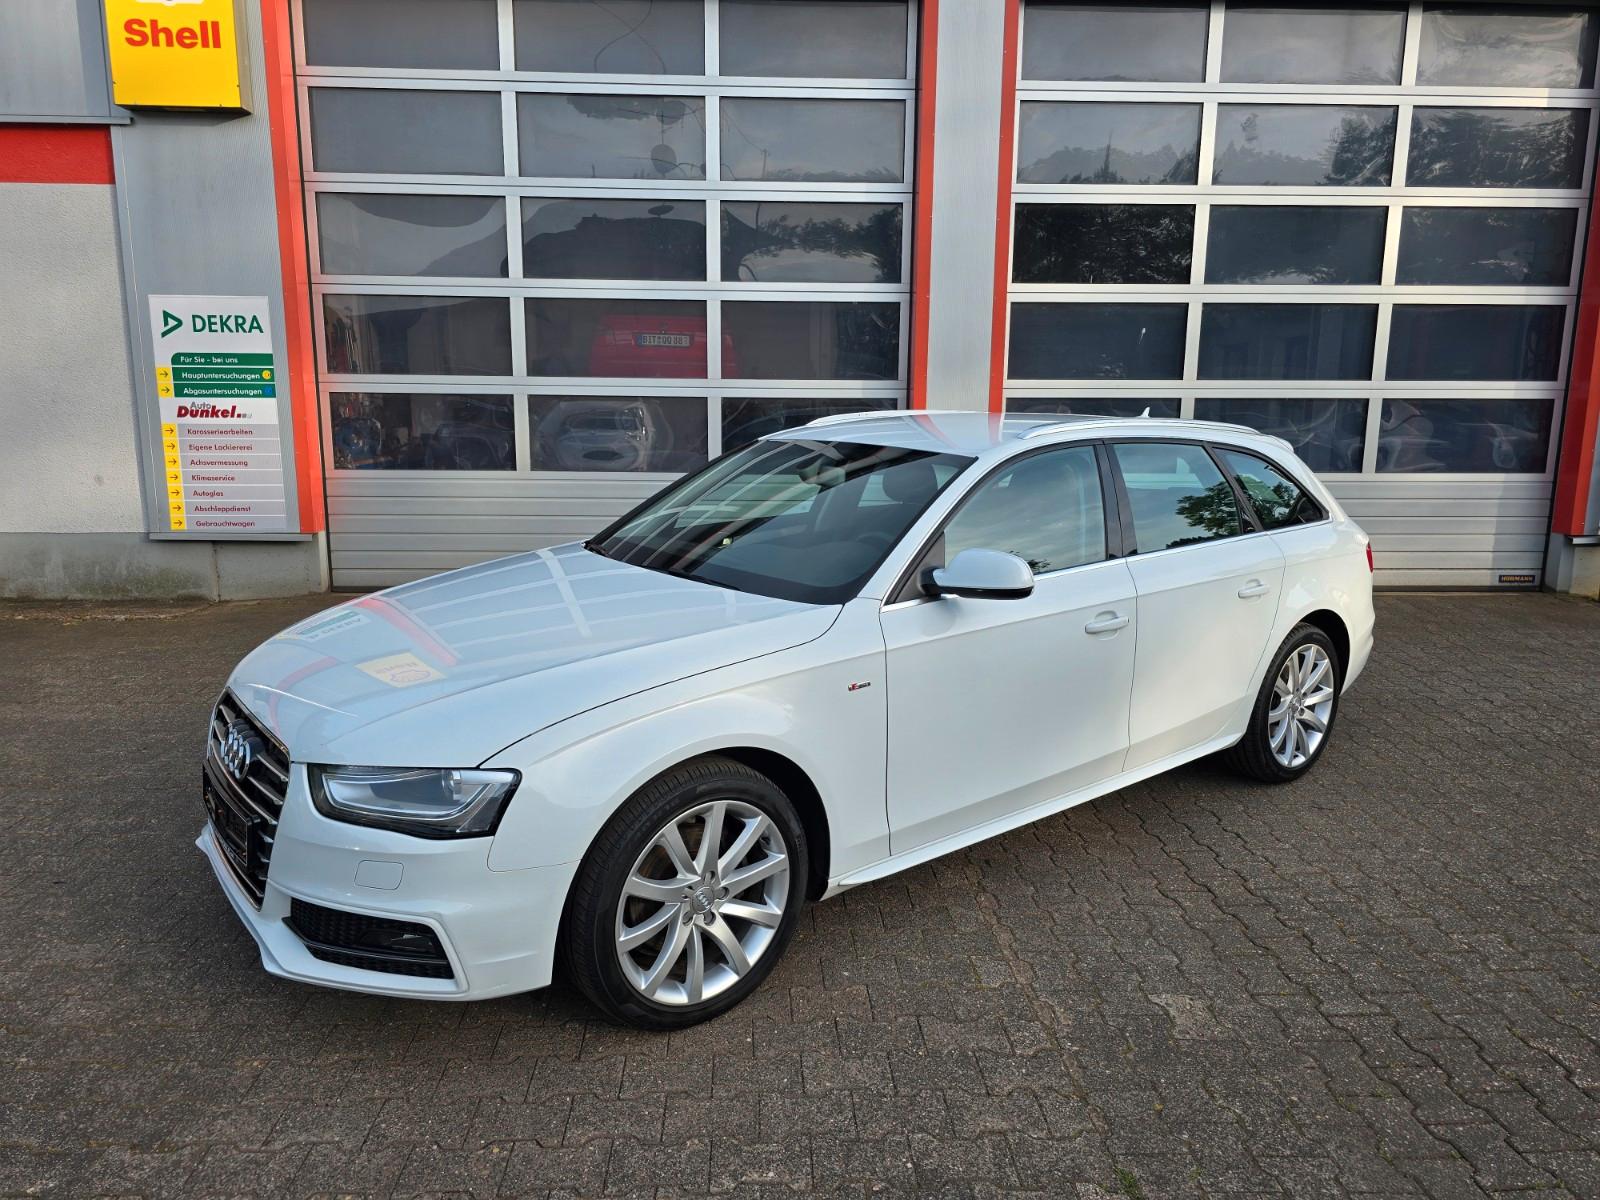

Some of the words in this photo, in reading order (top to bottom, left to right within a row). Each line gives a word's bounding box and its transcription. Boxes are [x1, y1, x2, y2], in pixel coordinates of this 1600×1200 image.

[124, 18, 221, 49] Shell
[191, 314, 264, 334] DEKRA
[182, 372, 261, 381] Hauptuntersuchungen
[183, 387, 262, 396] Abgasuntersuchungen
[190, 402, 211, 410] Auto
[187, 428, 253, 436] Karosseriearbeiten
[189, 444, 213, 452] Eigene
[190, 459, 248, 468] Achsvermessung
[192, 474, 235, 482] Klimaservice
[193, 490, 224, 498] Autoglas
[194, 505, 251, 514] Abschleppdienst
[195, 520, 255, 528] Gebrauchtwagen
